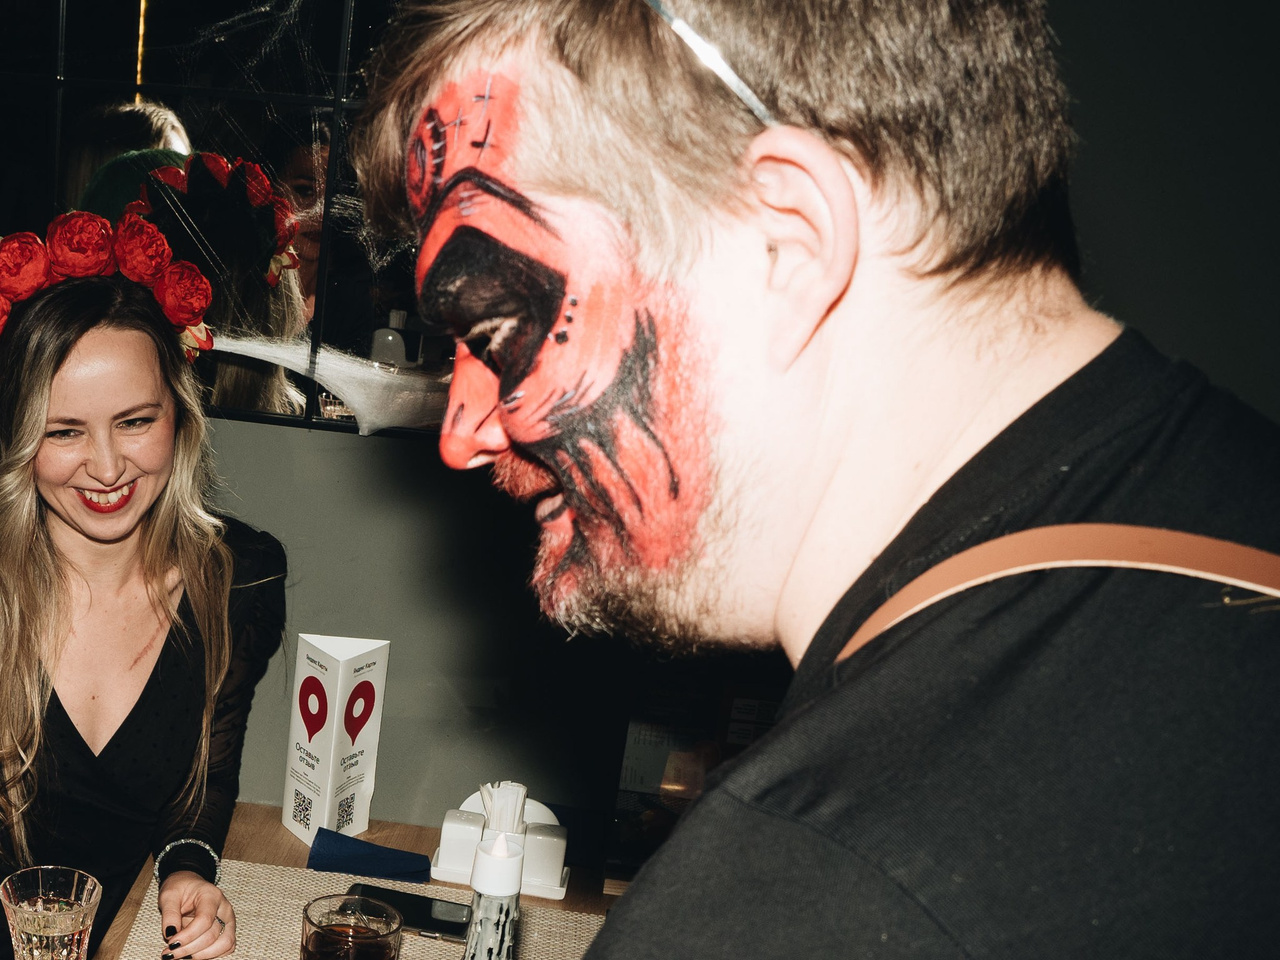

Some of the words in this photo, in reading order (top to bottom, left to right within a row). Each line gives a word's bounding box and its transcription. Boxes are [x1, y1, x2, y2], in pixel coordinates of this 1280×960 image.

[295, 742, 320, 765] Оставьте
[340, 749, 365, 767] Оставьте
[298, 755, 316, 771] отзыв
[343, 759, 359, 773] отзыв
